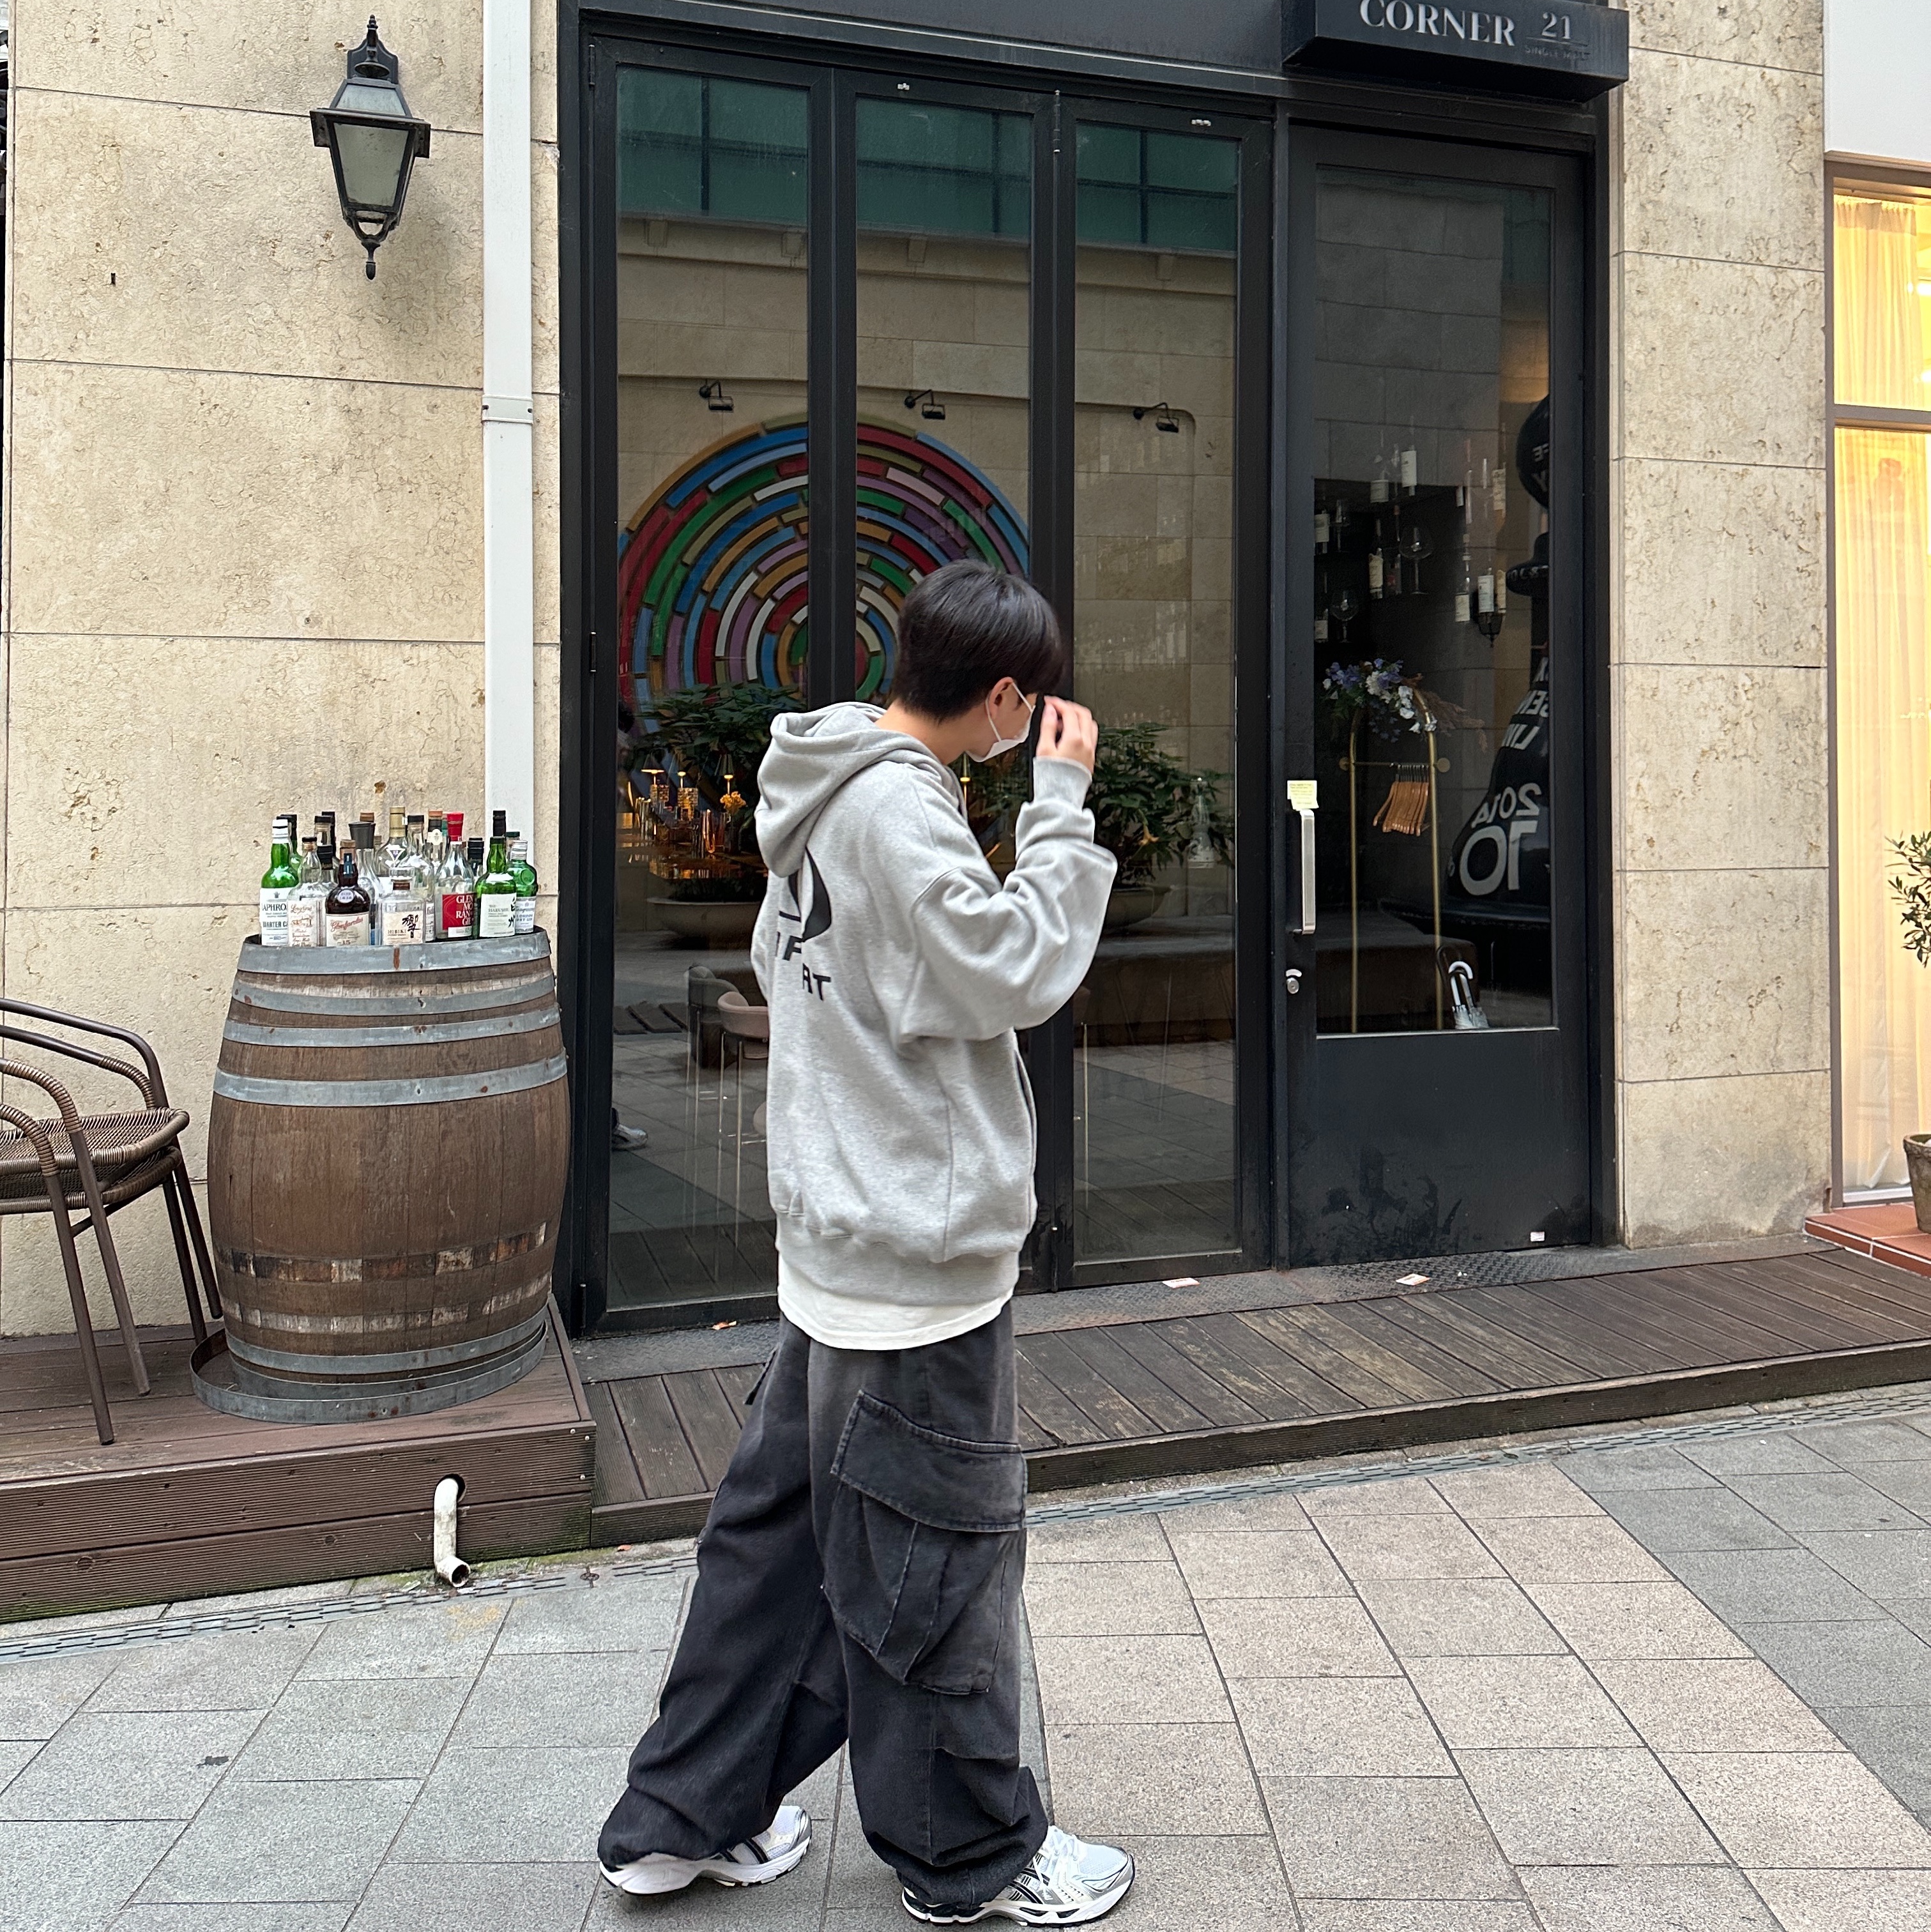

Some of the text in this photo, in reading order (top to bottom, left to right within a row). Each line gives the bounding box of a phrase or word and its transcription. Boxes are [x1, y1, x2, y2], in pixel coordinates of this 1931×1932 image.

[1359, 0, 1571, 47] CORNER 21
[456, 895, 473, 904] GLEN
[262, 903, 287, 911] APHRO
